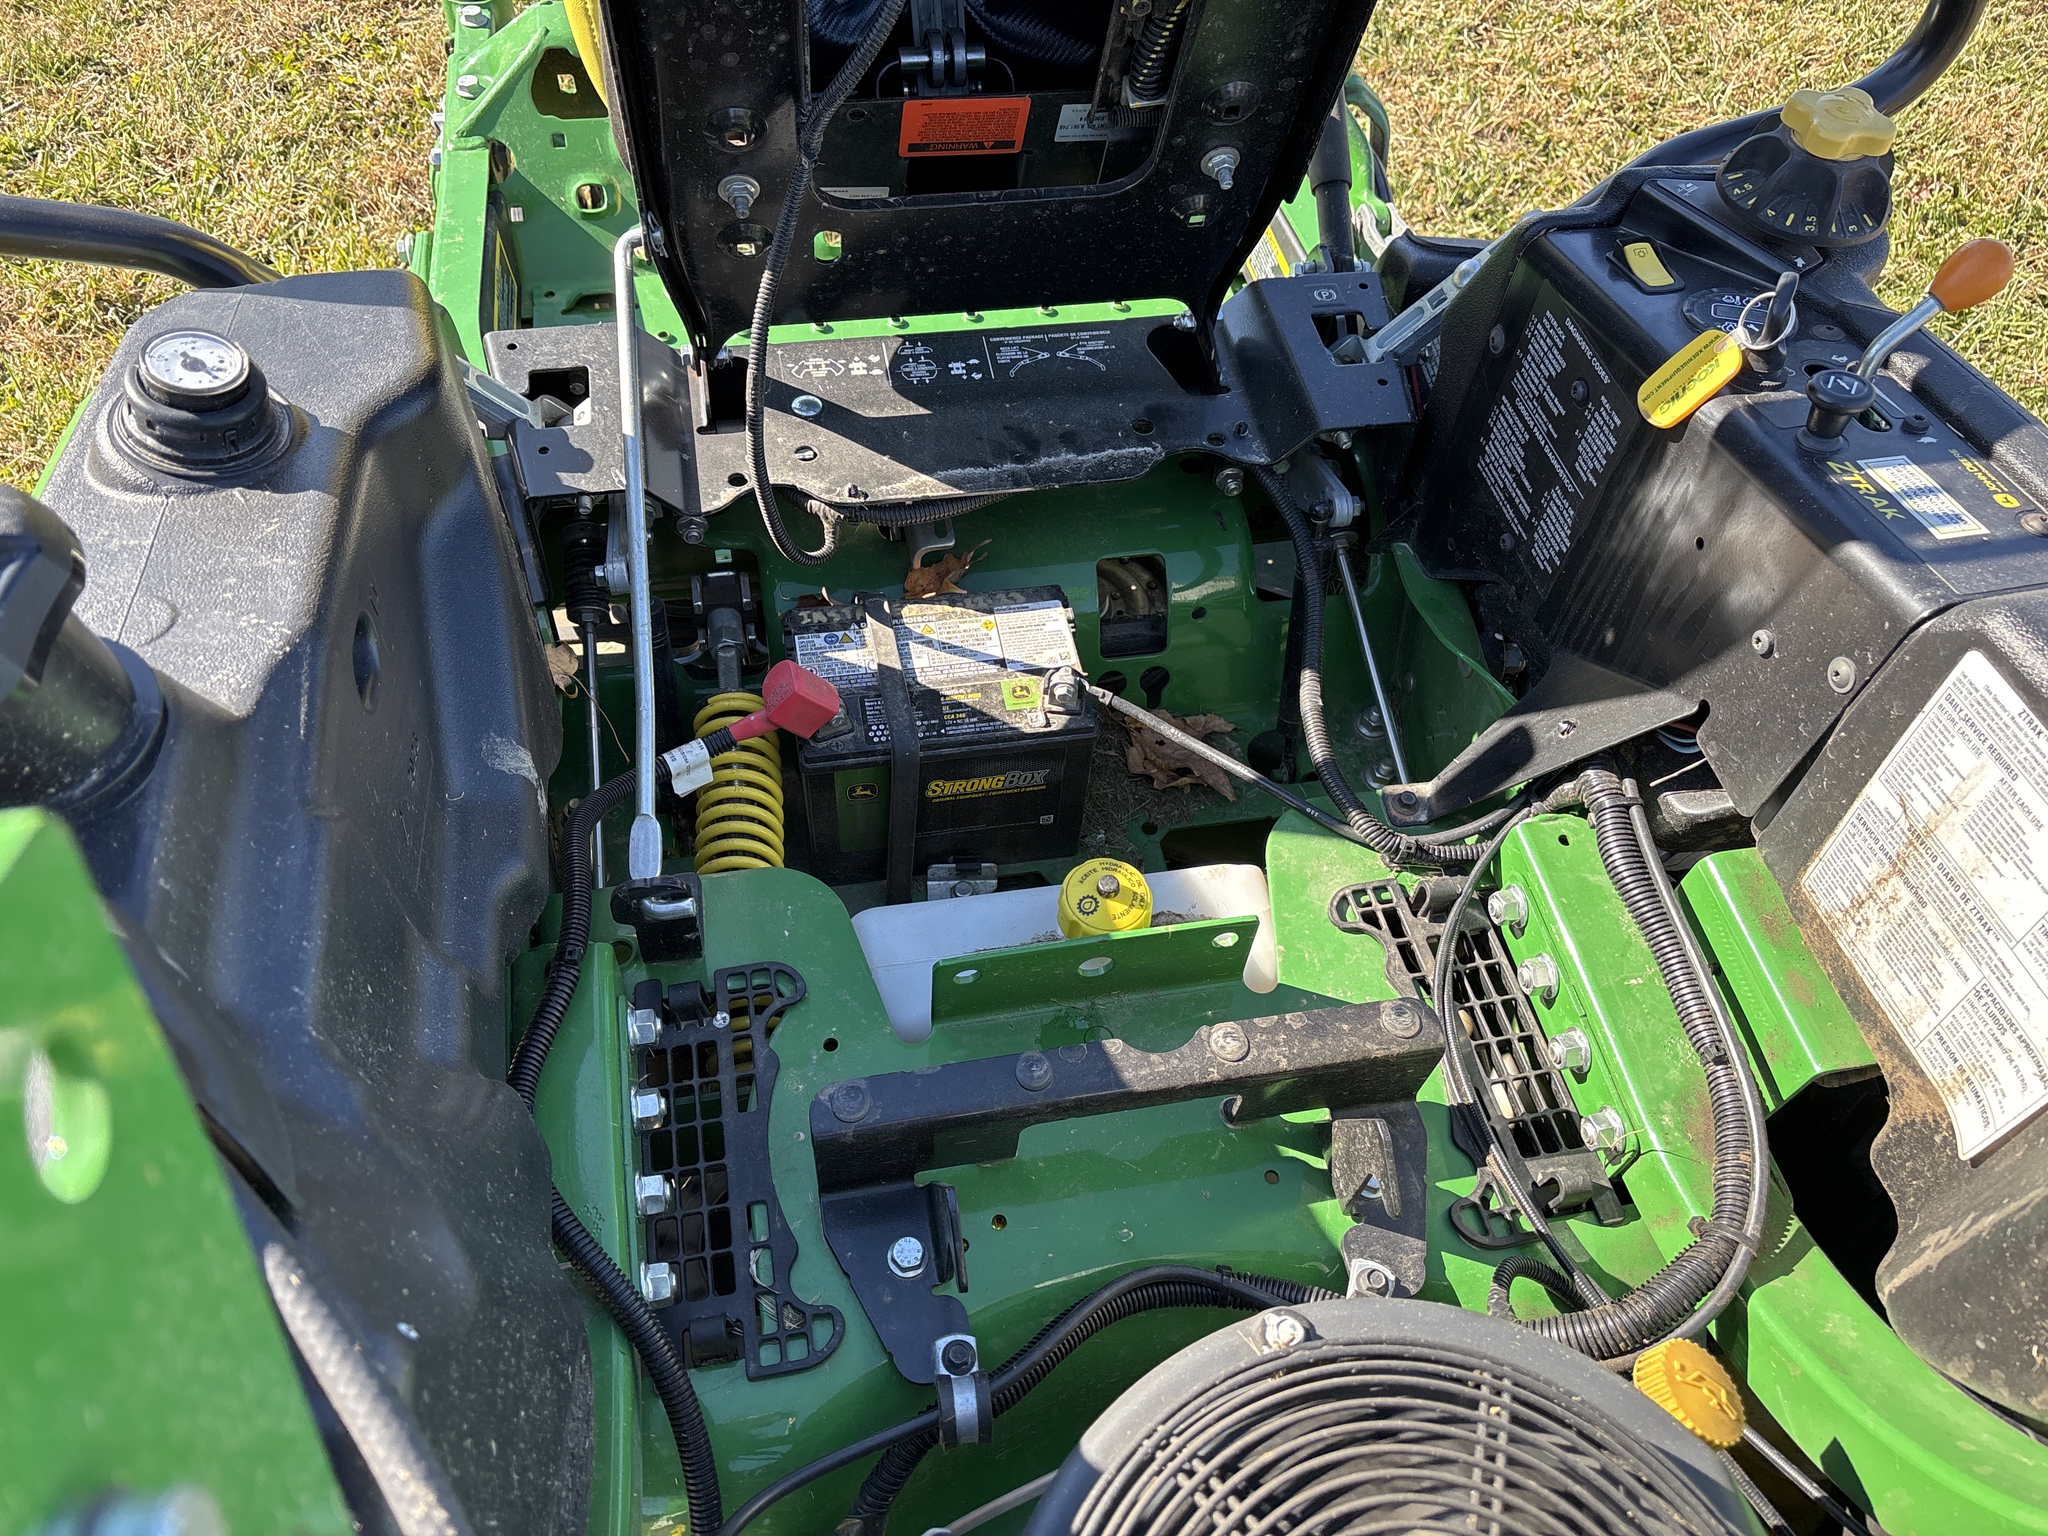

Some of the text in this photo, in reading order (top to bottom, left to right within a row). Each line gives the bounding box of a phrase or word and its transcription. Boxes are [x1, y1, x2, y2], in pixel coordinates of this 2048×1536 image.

[929, 142, 978, 150] WARNING
[1733, 182, 1753, 195] 4.5
[1766, 209, 1776, 218] 4
[1805, 215, 1817, 232] 3.5
[1564, 316, 1592, 357] DIAGNOSTIC
[1599, 406, 1615, 429] FAULTS
[1600, 395, 1621, 426] REAL-TIME
[1532, 427, 1545, 445] PARA
[1598, 432, 1614, 454] BATTERY
[1601, 424, 1617, 446] VOLTAGE
[1591, 457, 1603, 473] FAULT
[1970, 471, 2002, 493] JOHN
[1549, 489, 1564, 510] TIEMPO
[1554, 486, 1569, 507] FALLAS
[1937, 702, 1983, 758] BEFORE EACH USE
[1943, 692, 2019, 782] DAILY SERVICE REQUIRED
[956, 792, 985, 800] EQUIPMENT
[1998, 776, 2044, 832] AFTER EACH USE
[1849, 819, 1886, 868] ANTES DE CADA USO
[1099, 861, 1136, 876] HYDRAULIC
[1854, 812, 1927, 910] SERVICIO DIARIO REQUERIDO
[1906, 823, 1938, 864] SERVICIO
[1936, 862, 1961, 893] DIARIO
[1959, 891, 1971, 906] DE
[1078, 867, 1098, 884] ACEITE
[1973, 989, 2007, 1036] DE FLUIDOS
[1980, 982, 2018, 1034] CAPACIDADES
[1966, 998, 1989, 1027] (INCLUYE
[1988, 1028, 2007, 1055] CAMBIO
[2007, 1055, 2014, 1065] DE
[1934, 1031, 1958, 1065] PRESIÓN
[1957, 1065, 1966, 1077] DE
